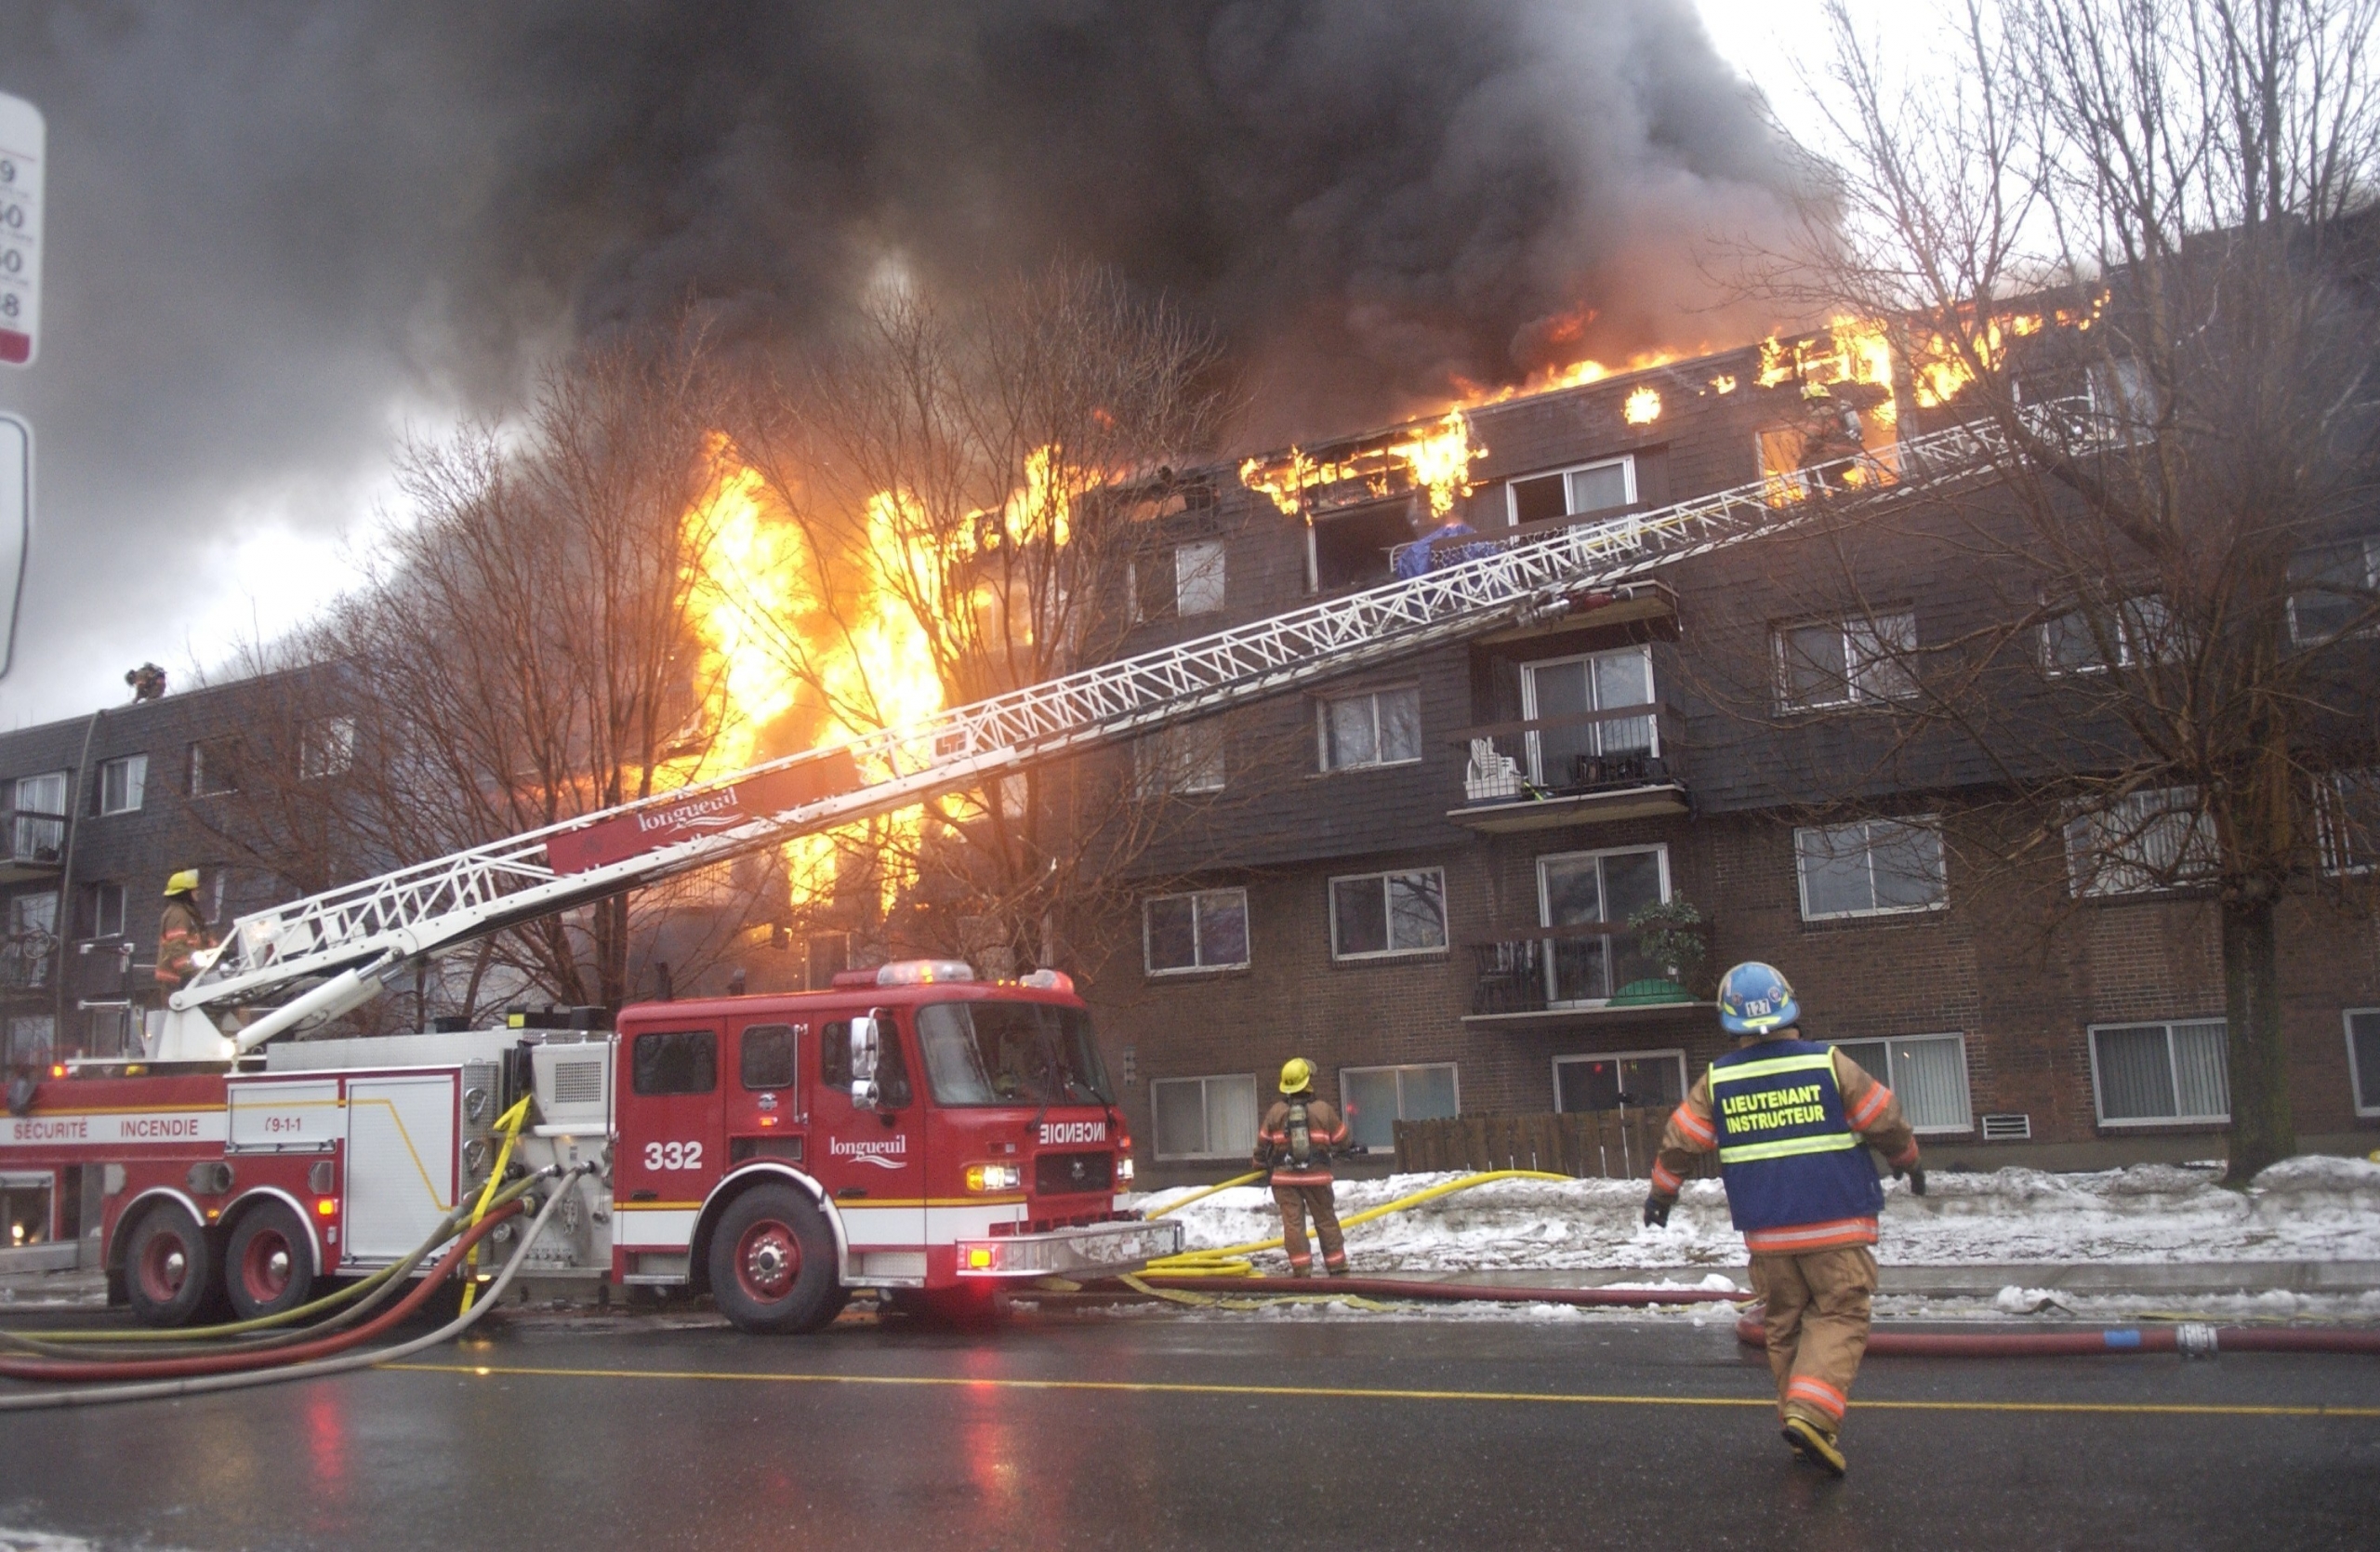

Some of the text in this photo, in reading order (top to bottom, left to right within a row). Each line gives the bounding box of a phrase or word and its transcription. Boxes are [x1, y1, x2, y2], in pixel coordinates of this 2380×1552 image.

[0, 203, 23, 230] 0
[638, 787, 738, 831] longueuil
[1747, 1000, 1768, 1016] 127
[1722, 1084, 1821, 1115] LIEUTENANT
[14, 1116, 199, 1139] SÉCURITÉ INCENDIE
[1726, 1105, 1826, 1134] INSTRUCTEUR
[645, 1141, 702, 1170] 332
[830, 1135, 906, 1159] longueuil
